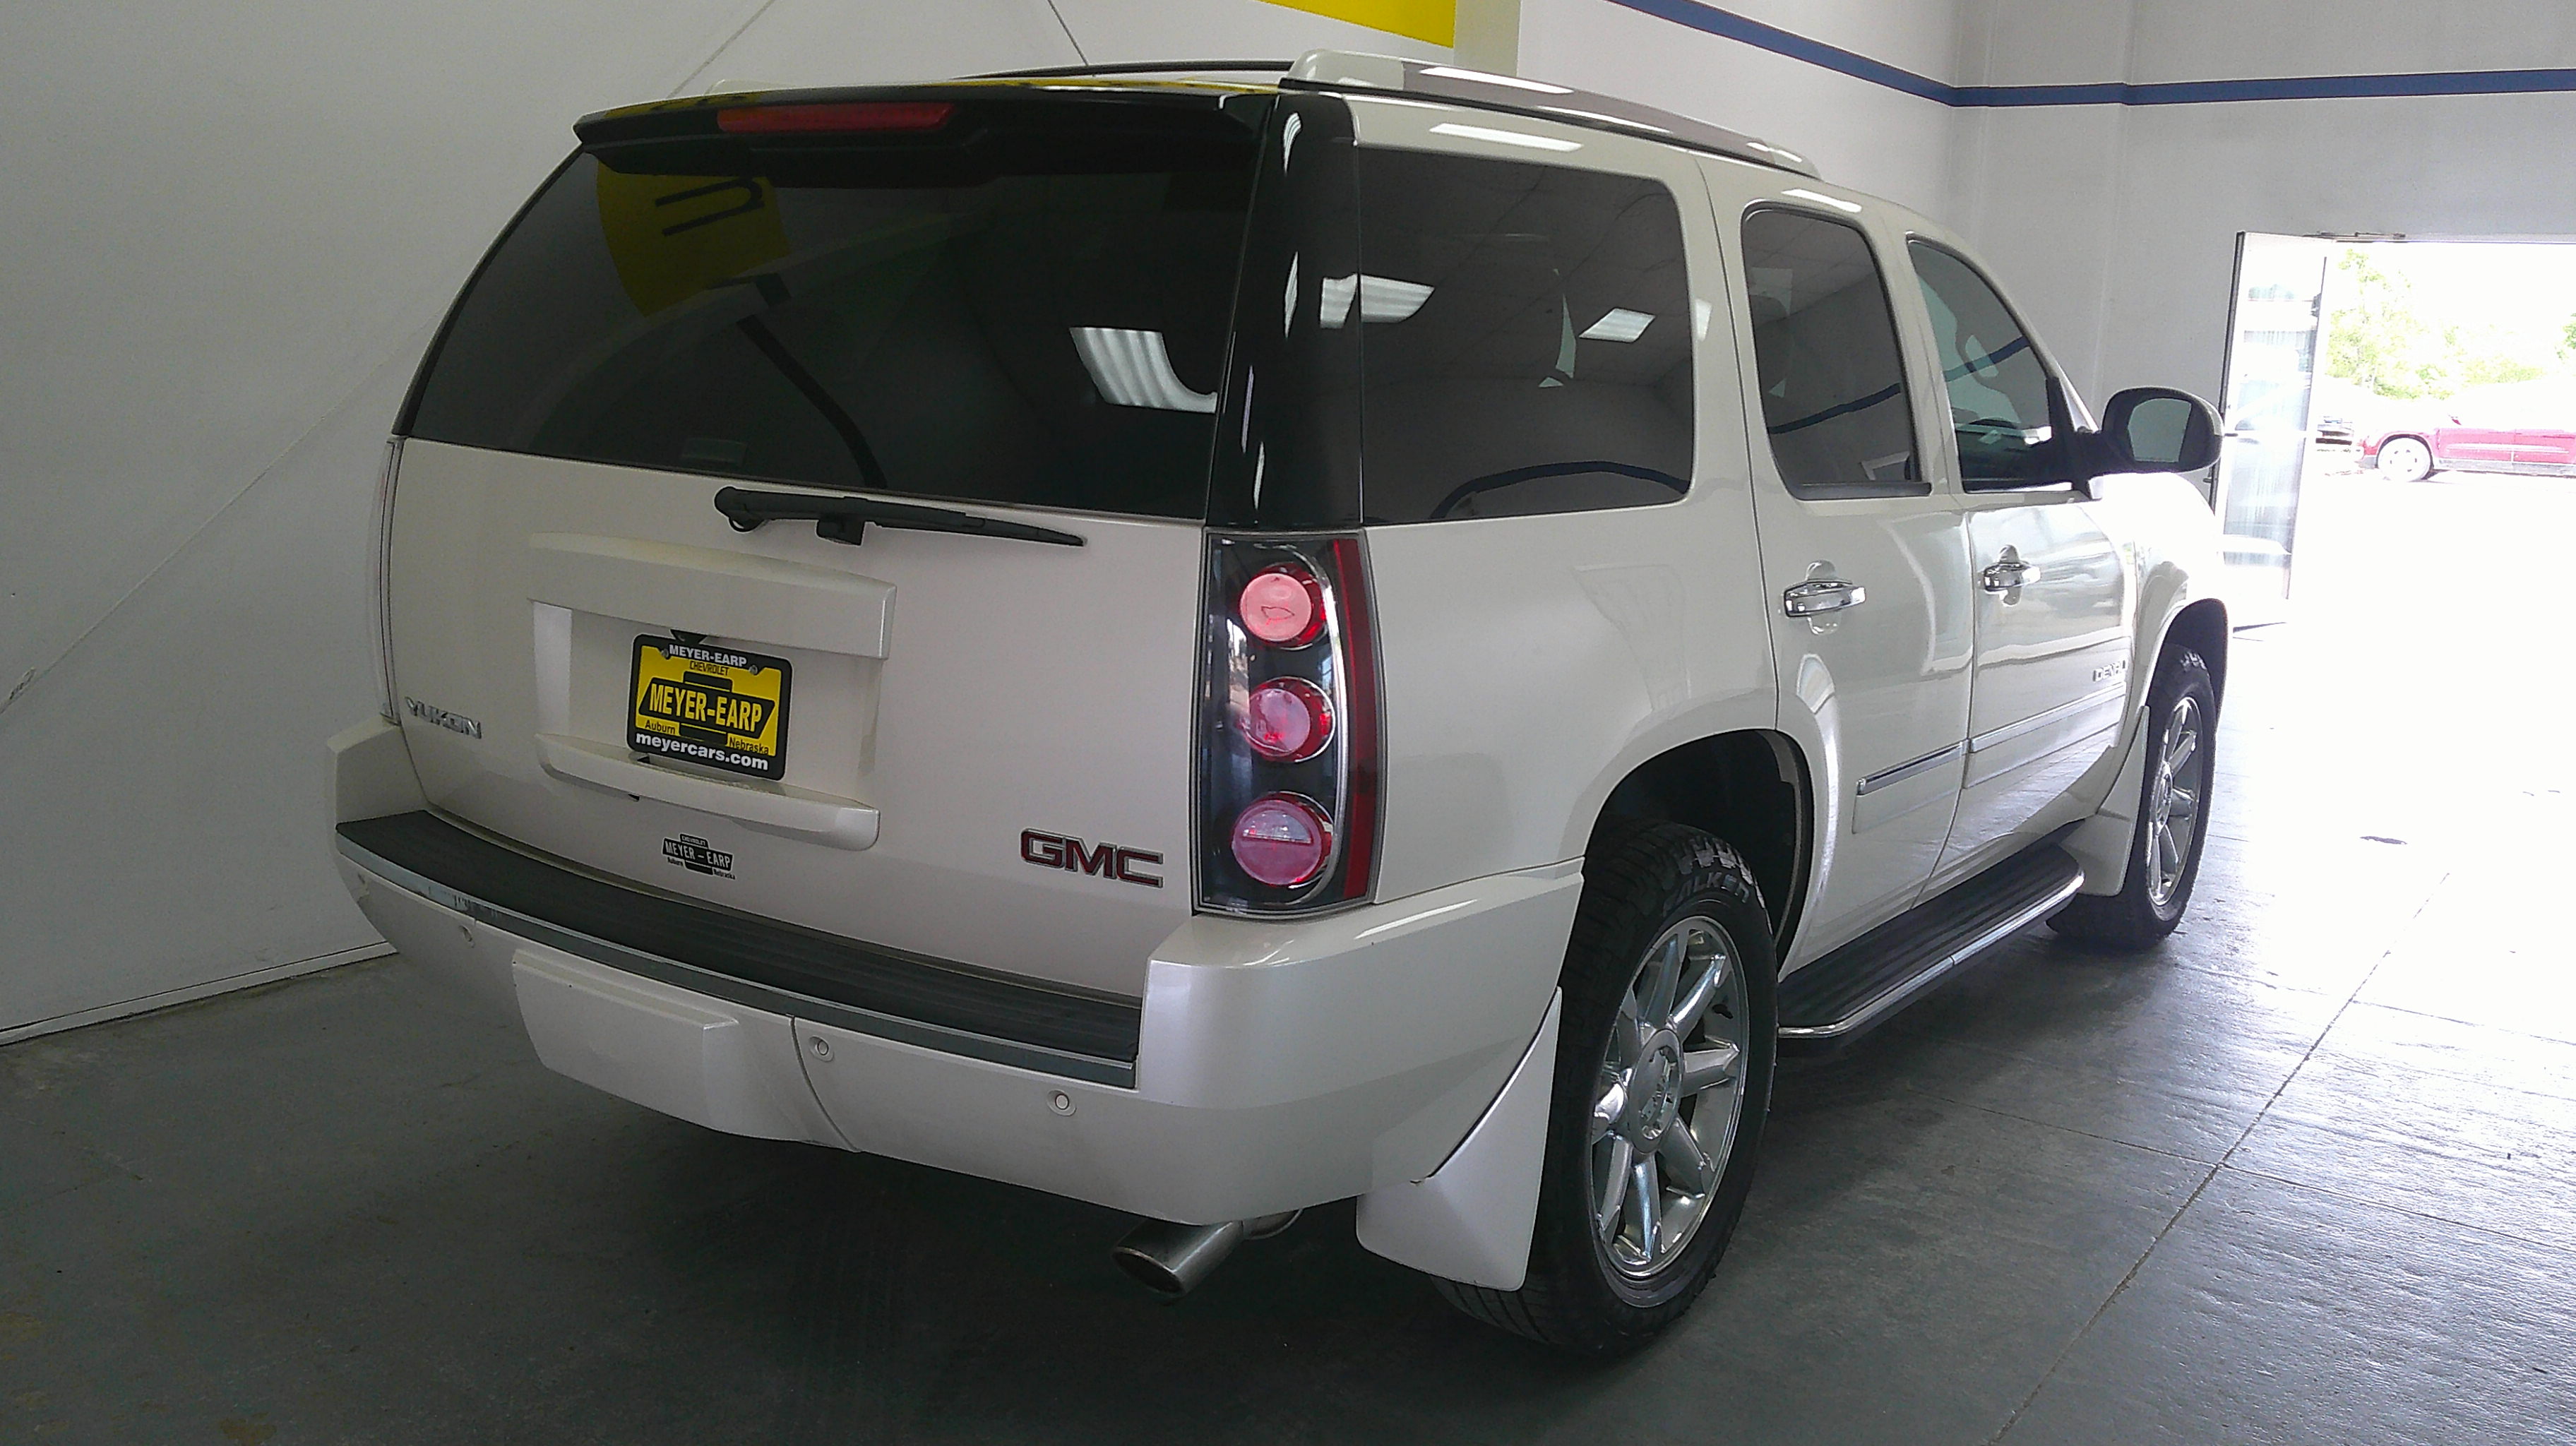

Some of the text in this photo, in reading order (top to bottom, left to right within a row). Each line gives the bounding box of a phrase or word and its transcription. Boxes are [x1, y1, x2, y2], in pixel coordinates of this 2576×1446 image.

[669, 644, 747, 667] MEYER-EARP
[689, 660, 729, 676] CHEVROLET
[649, 682, 763, 733] MEYER-EARP
[645, 719, 676, 735] Auburn
[636, 732, 769, 771] meyercars.com
[729, 736, 770, 755] Nebraska
[1020, 827, 1164, 889] GMC
